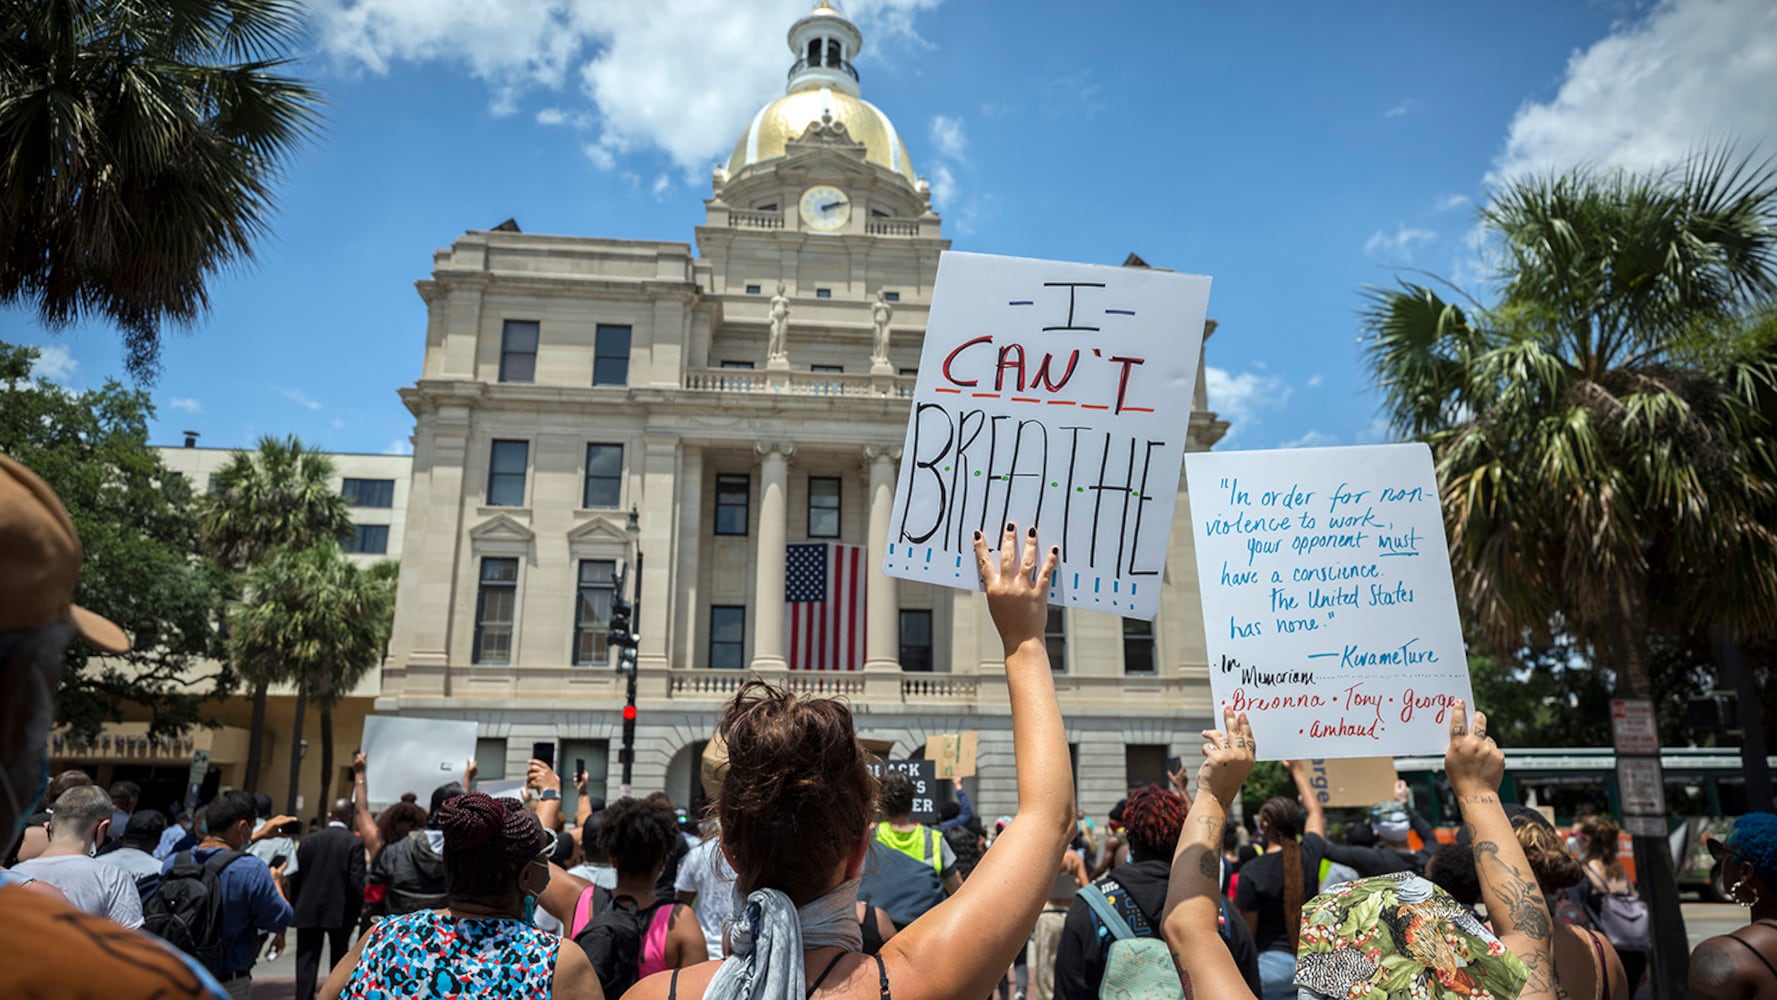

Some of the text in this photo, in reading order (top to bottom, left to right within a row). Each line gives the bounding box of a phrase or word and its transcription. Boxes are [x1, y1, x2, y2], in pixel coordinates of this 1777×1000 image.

[942, 335, 1145, 415] CAN'T
[899, 402, 1165, 579] BREATHE
[1261, 484, 1316, 509] order
[1328, 482, 1372, 513] for
[1206, 511, 1292, 536] violence
[1298, 511, 1316, 530] to
[1247, 526, 1424, 567] your opponent must
[1221, 561, 1258, 587] have
[1271, 571, 1283, 583] a
[1308, 585, 1359, 609] United
[1369, 581, 1414, 606] States
[1231, 616, 1262, 639] has
[1232, 688, 1326, 711] Breonna
[1344, 682, 1386, 723] Tony
